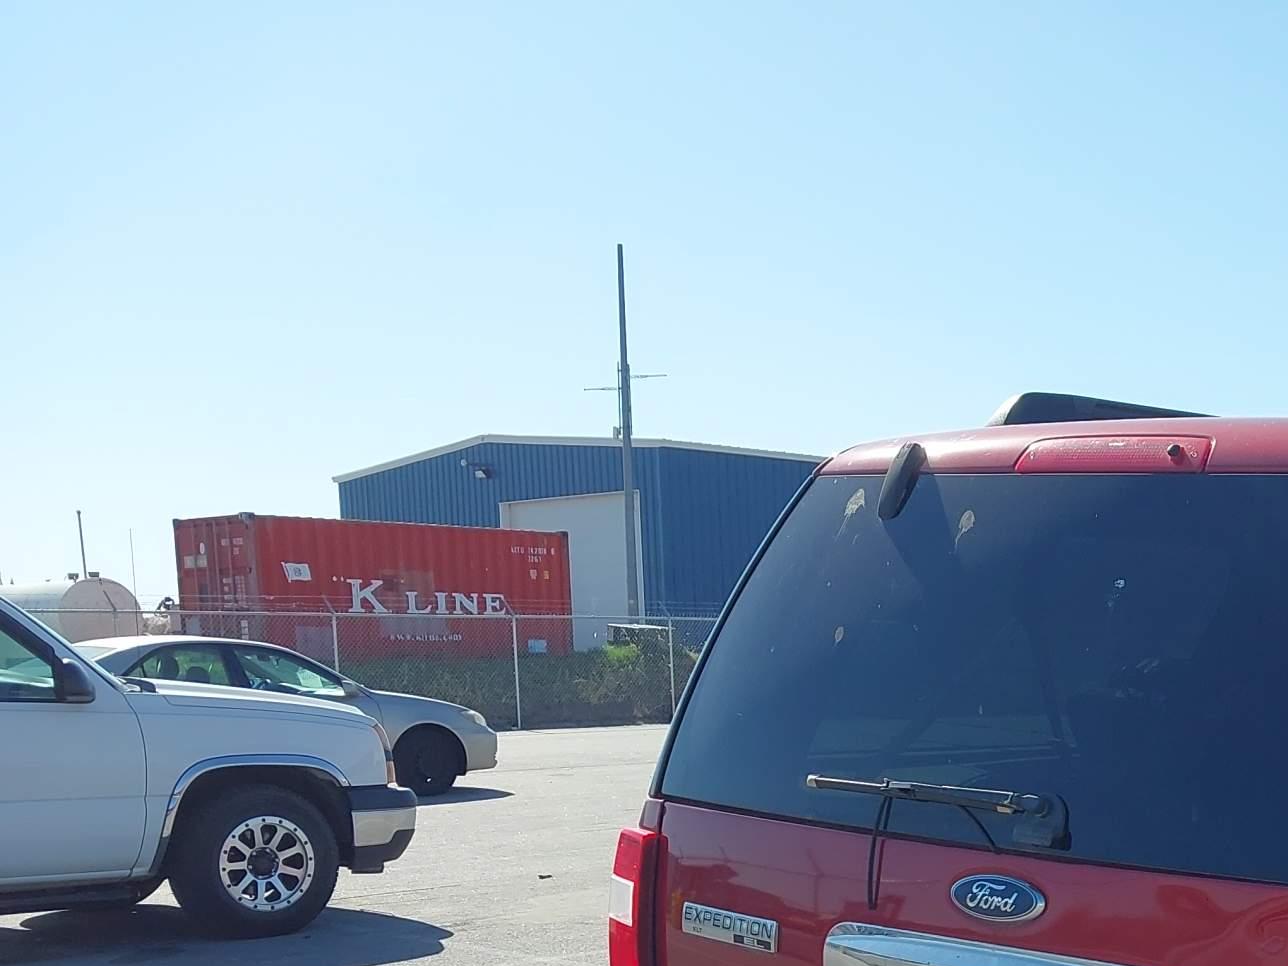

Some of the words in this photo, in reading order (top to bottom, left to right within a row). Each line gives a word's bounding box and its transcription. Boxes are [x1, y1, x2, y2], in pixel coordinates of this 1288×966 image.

[405, 591, 507, 615] LINE
[966, 881, 1018, 912] Ford
[684, 906, 773, 939] EXPEDITION
